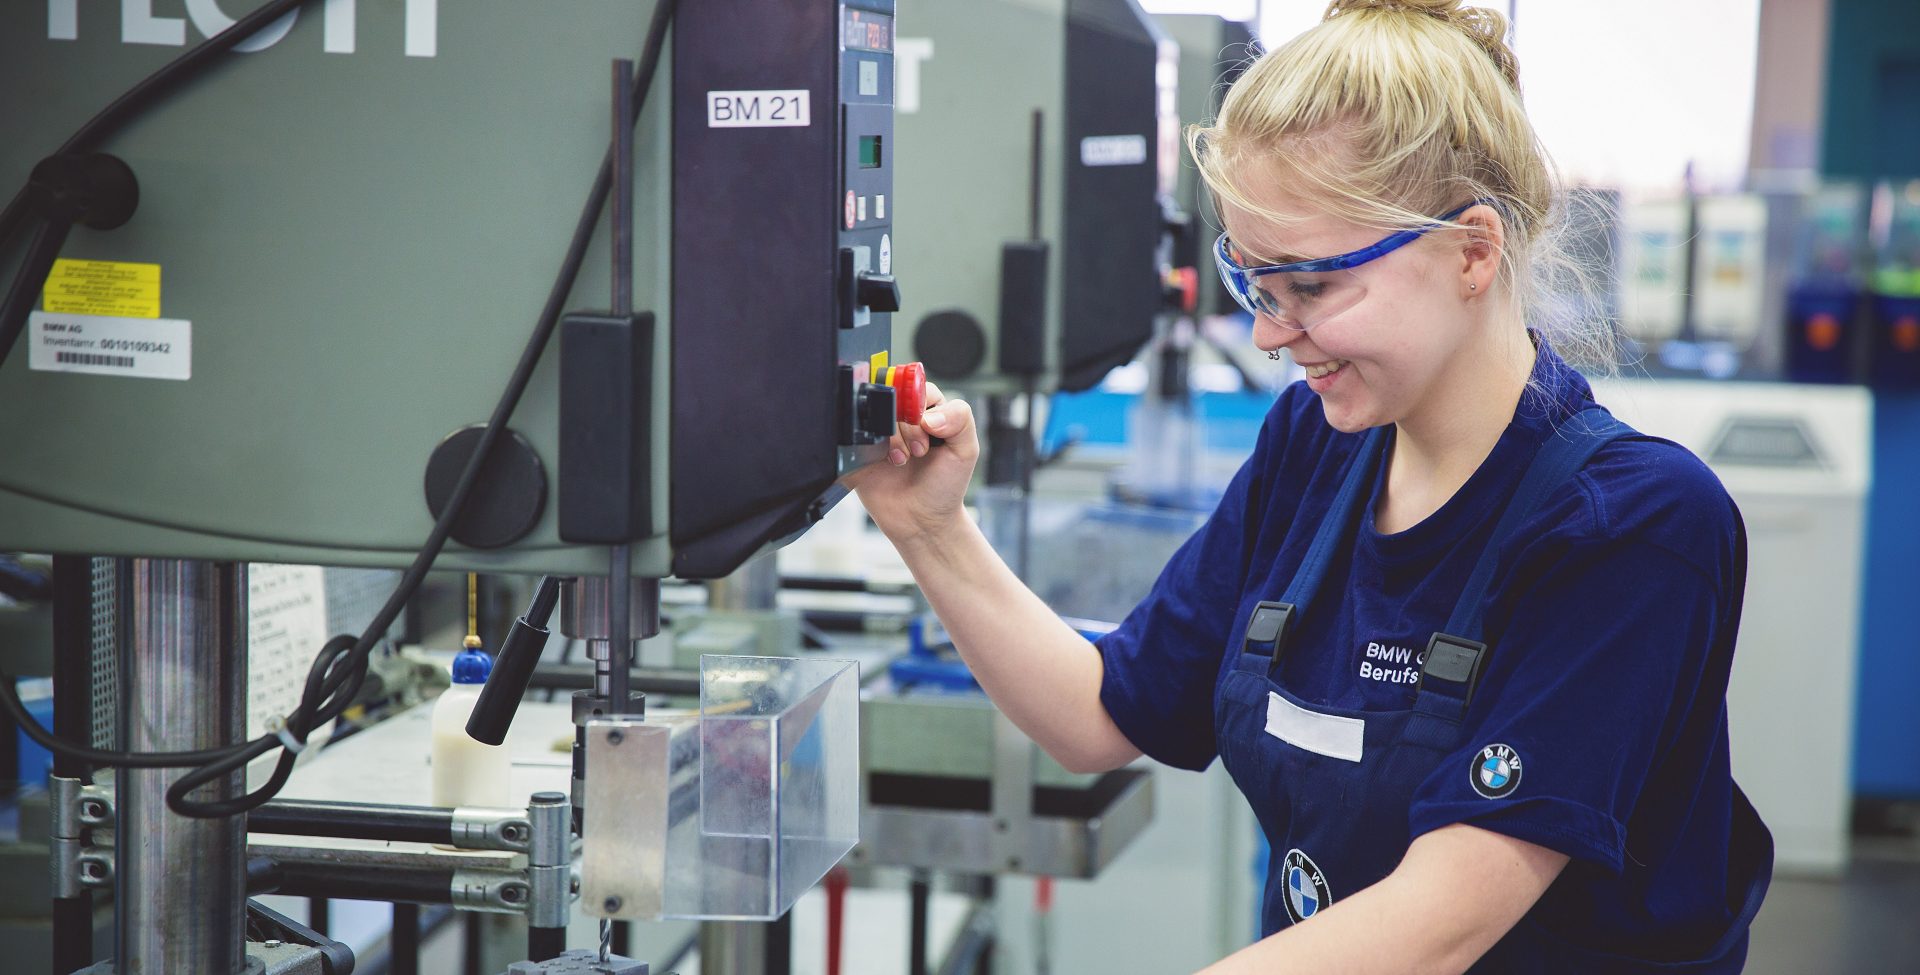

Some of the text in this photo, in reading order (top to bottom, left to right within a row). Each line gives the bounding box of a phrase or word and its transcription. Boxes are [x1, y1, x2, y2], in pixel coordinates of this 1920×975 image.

[714, 96, 800, 120] BM 21
[1366, 641, 1412, 665] BMW
[1483, 746, 1521, 770] BMW
